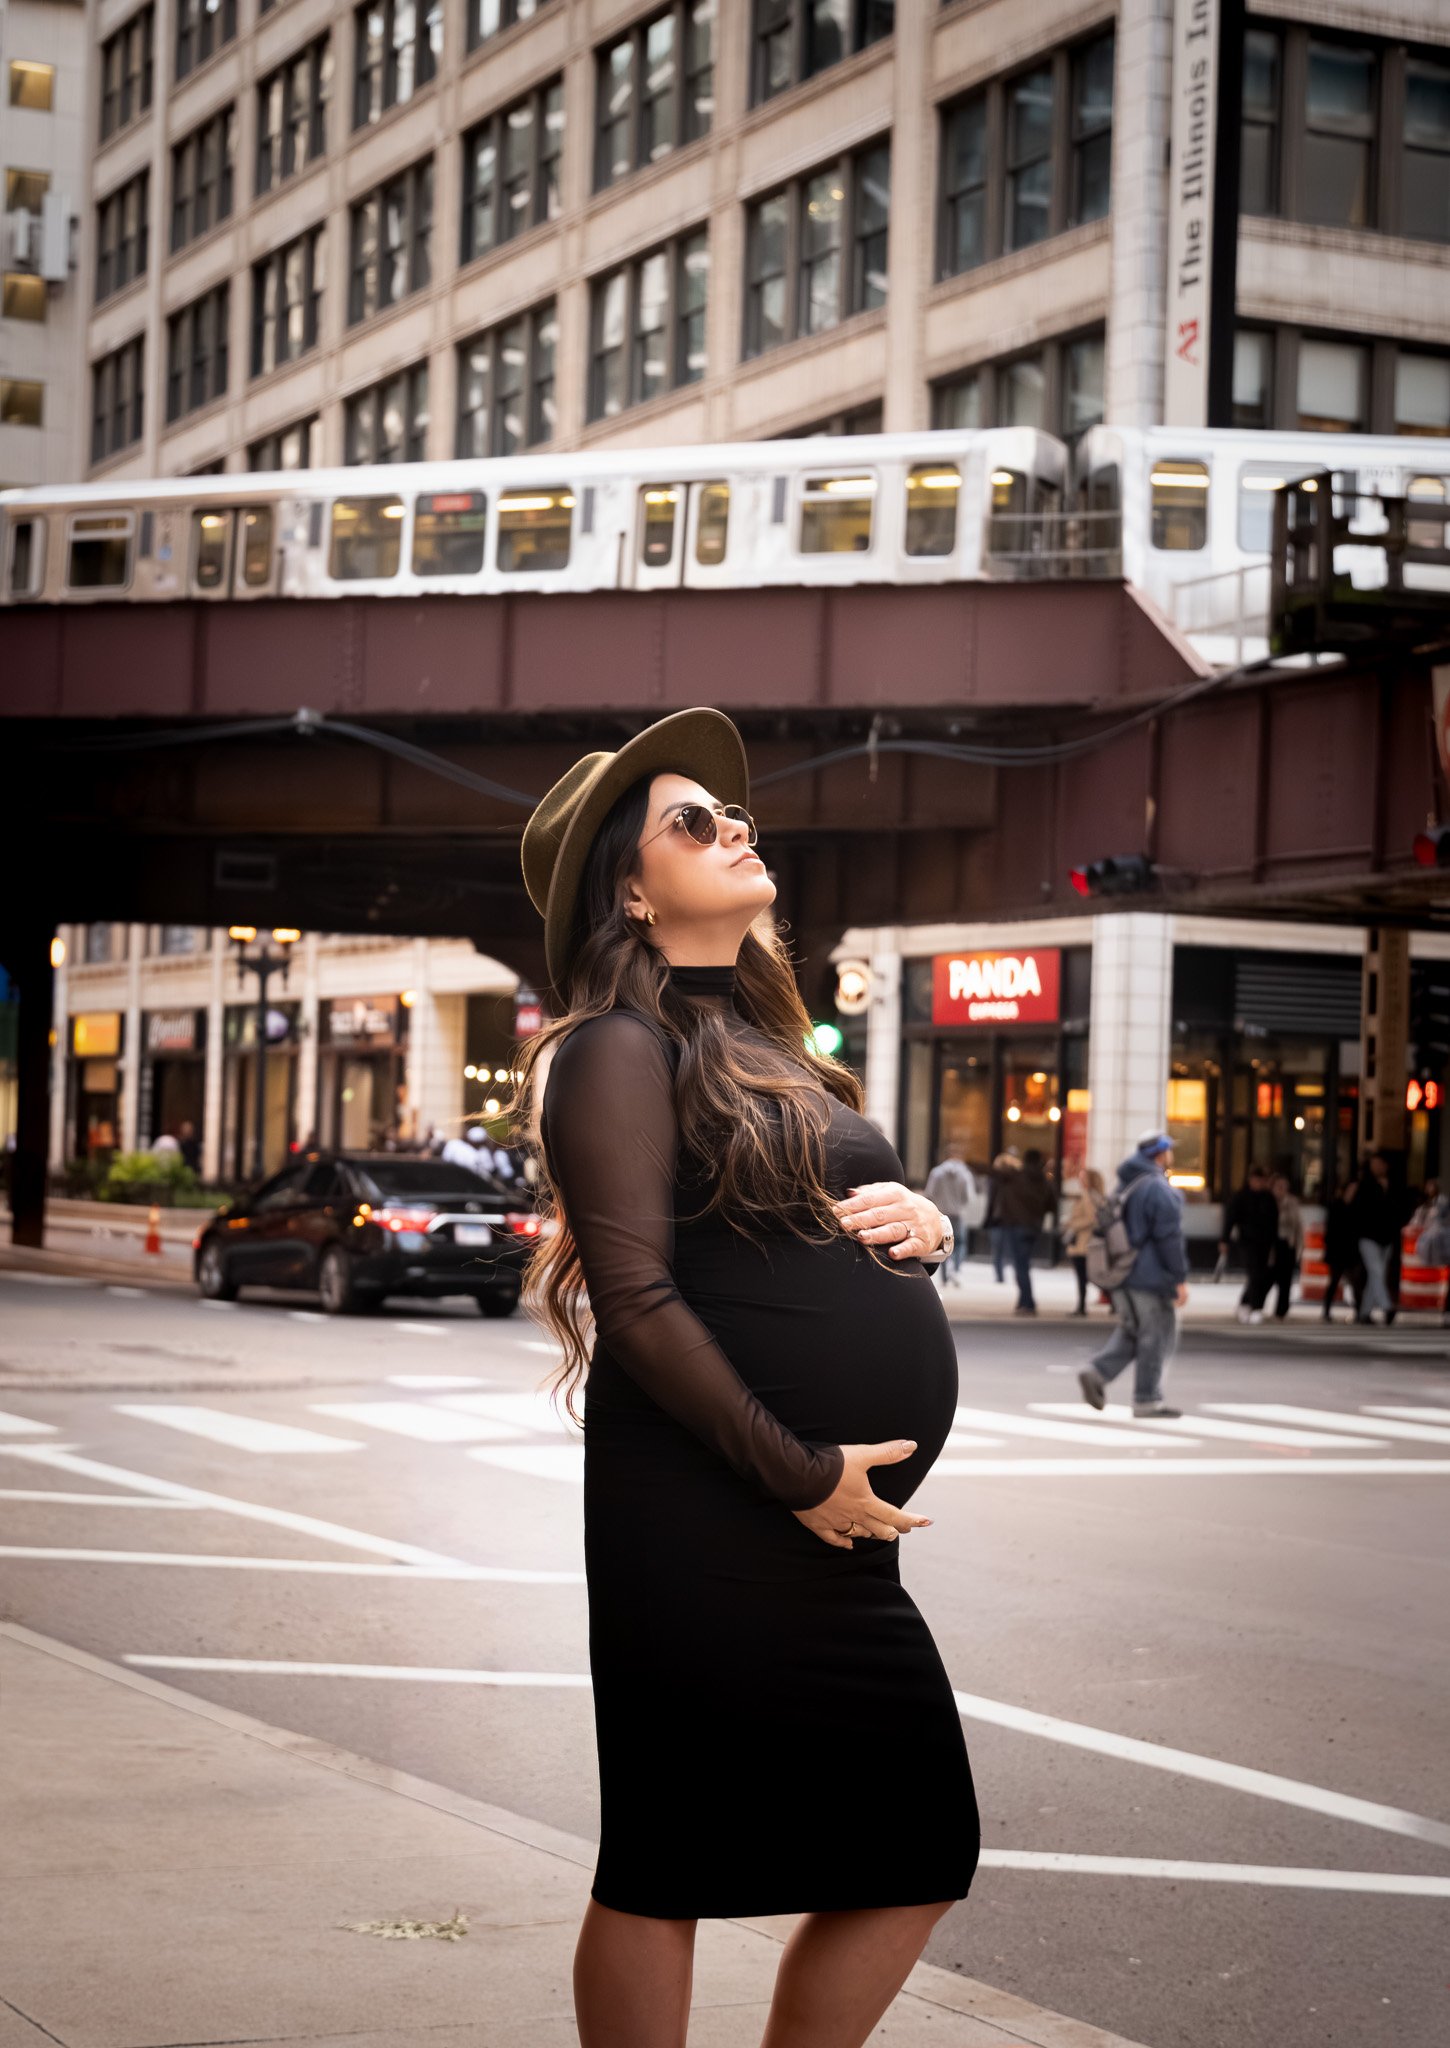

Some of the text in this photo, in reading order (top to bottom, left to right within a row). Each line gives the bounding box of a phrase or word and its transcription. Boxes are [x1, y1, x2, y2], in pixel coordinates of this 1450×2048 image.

[1181, 59, 1207, 206] Illinois
[1179, 220, 1202, 297] The
[949, 956, 1042, 1000] PANDA
